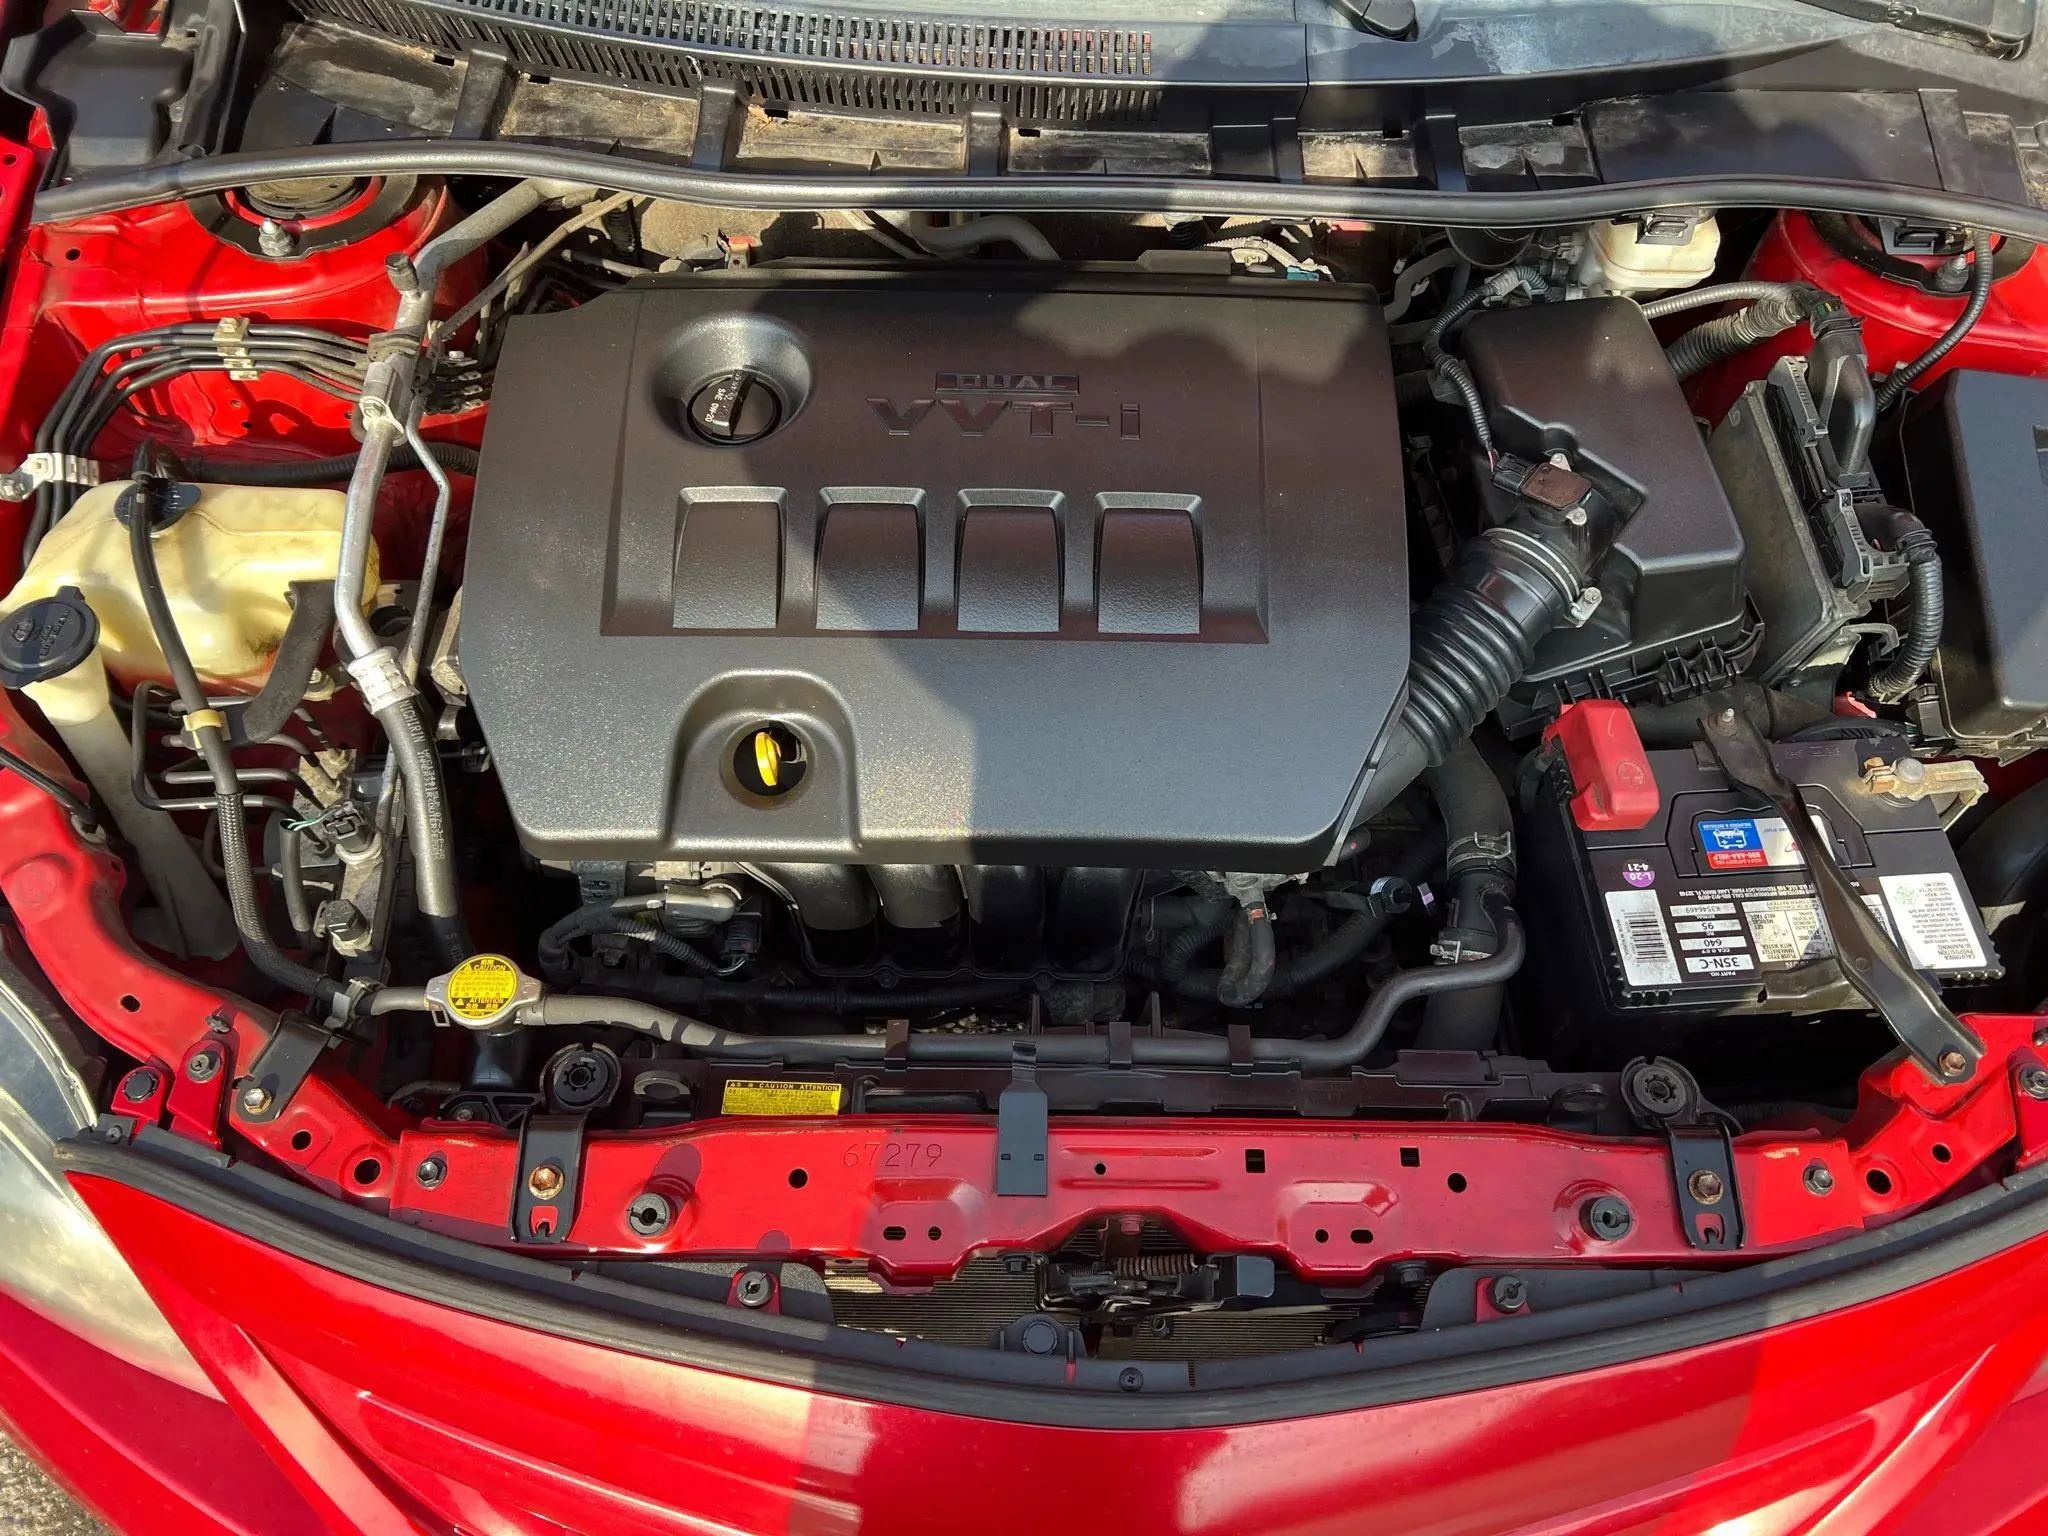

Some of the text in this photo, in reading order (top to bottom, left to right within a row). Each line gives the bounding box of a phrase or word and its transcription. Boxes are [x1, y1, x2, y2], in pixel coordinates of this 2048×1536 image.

[956, 374, 1068, 389] DUAL
[704, 388, 726, 423] SAE 0W-20
[866, 398, 1141, 441] VVT-i
[399, 699, 426, 743] NICHIRIN
[1712, 852, 1760, 860] 800-AAA-HELP
[1627, 863, 1649, 871] 4-21
[1629, 872, 1651, 880] L-20
[1744, 890, 1777, 898] INFORMATION
[1745, 885, 1776, 894] TECHNOLOGY
[1701, 922, 1714, 930] 95
[1703, 939, 1722, 947] 640
[1699, 957, 1740, 969] 35N-C
[843, 1142, 943, 1167] 67279
